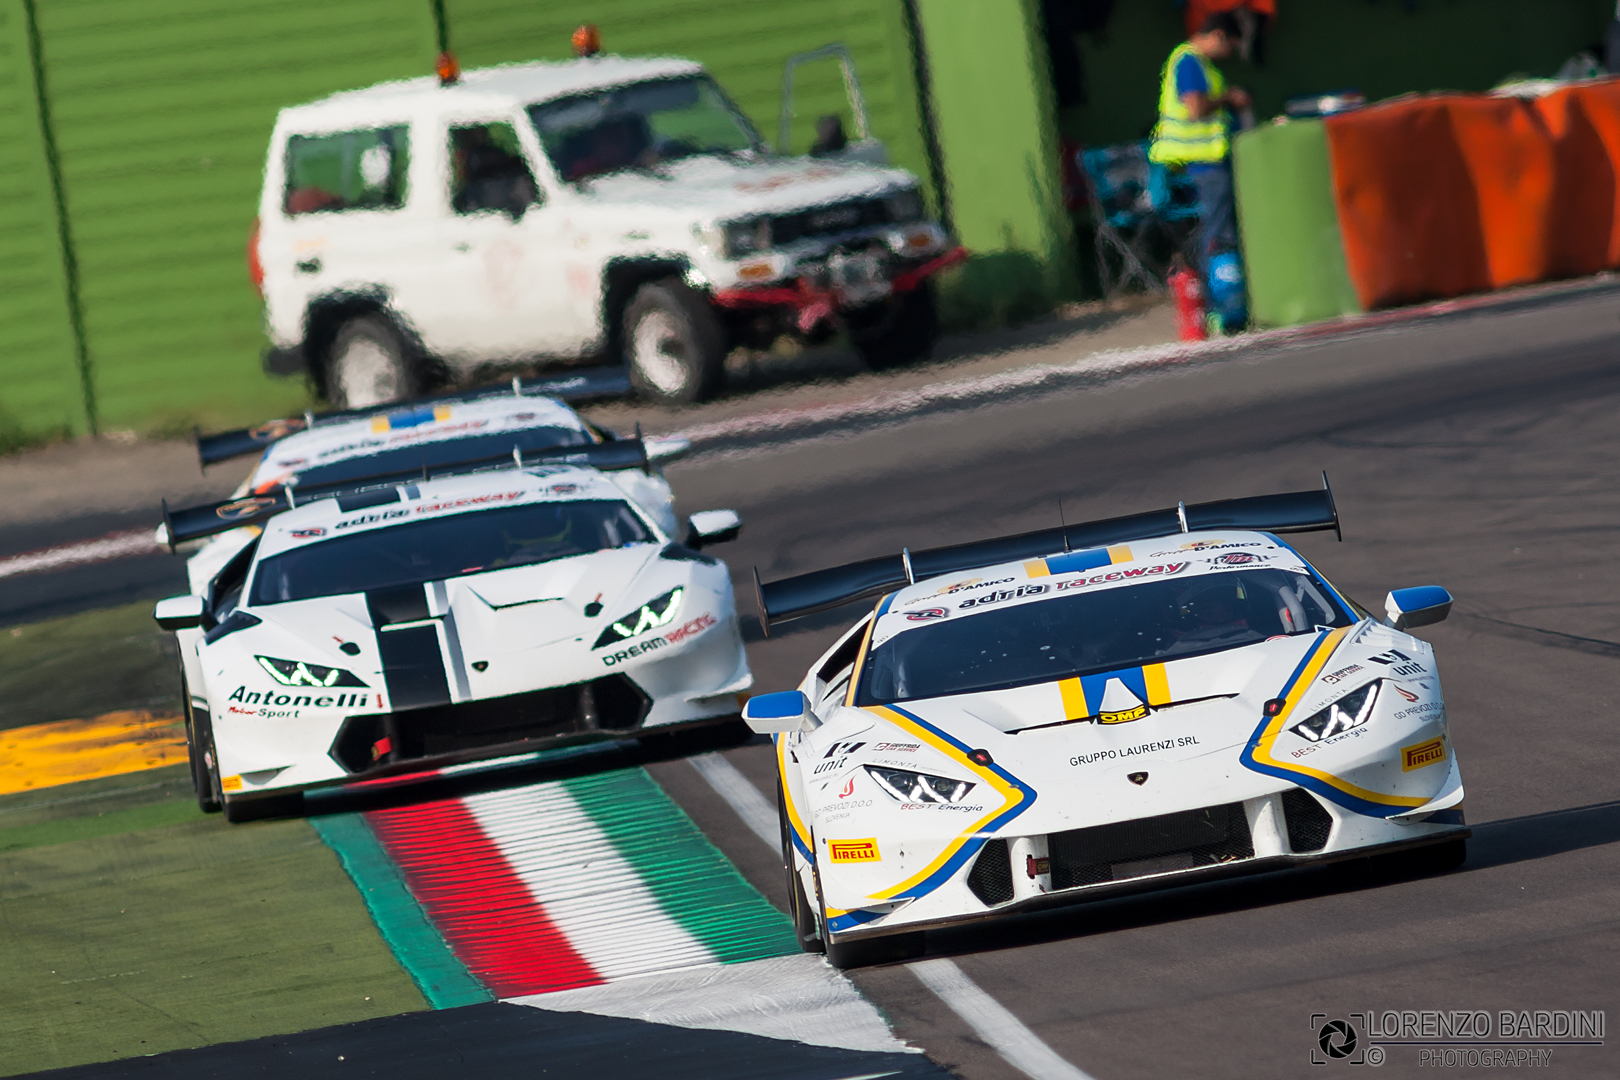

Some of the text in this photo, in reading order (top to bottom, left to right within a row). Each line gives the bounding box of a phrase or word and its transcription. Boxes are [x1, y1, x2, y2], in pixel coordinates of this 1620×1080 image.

[415, 490, 522, 514] raceway
[1194, 541, 1262, 552] D'AMICO
[948, 577, 1016, 595] D'AMICO
[958, 561, 1190, 609] adria raceway
[602, 637, 668, 667] DREAM
[1393, 661, 1428, 676] unit
[228, 685, 368, 708] Antonelli
[258, 708, 300, 719] Sport
[1101, 705, 1147, 723] OMP
[1069, 735, 1200, 767] GRUPPO LAURENZI SRL
[1291, 727, 1369, 759] BEST Energia
[872, 758, 918, 769] LIMONTA
[1406, 741, 1443, 767] PIRELLI
[813, 755, 848, 775] unit
[900, 803, 984, 812] BEST Energia
[831, 842, 875, 860] PIRELLI
